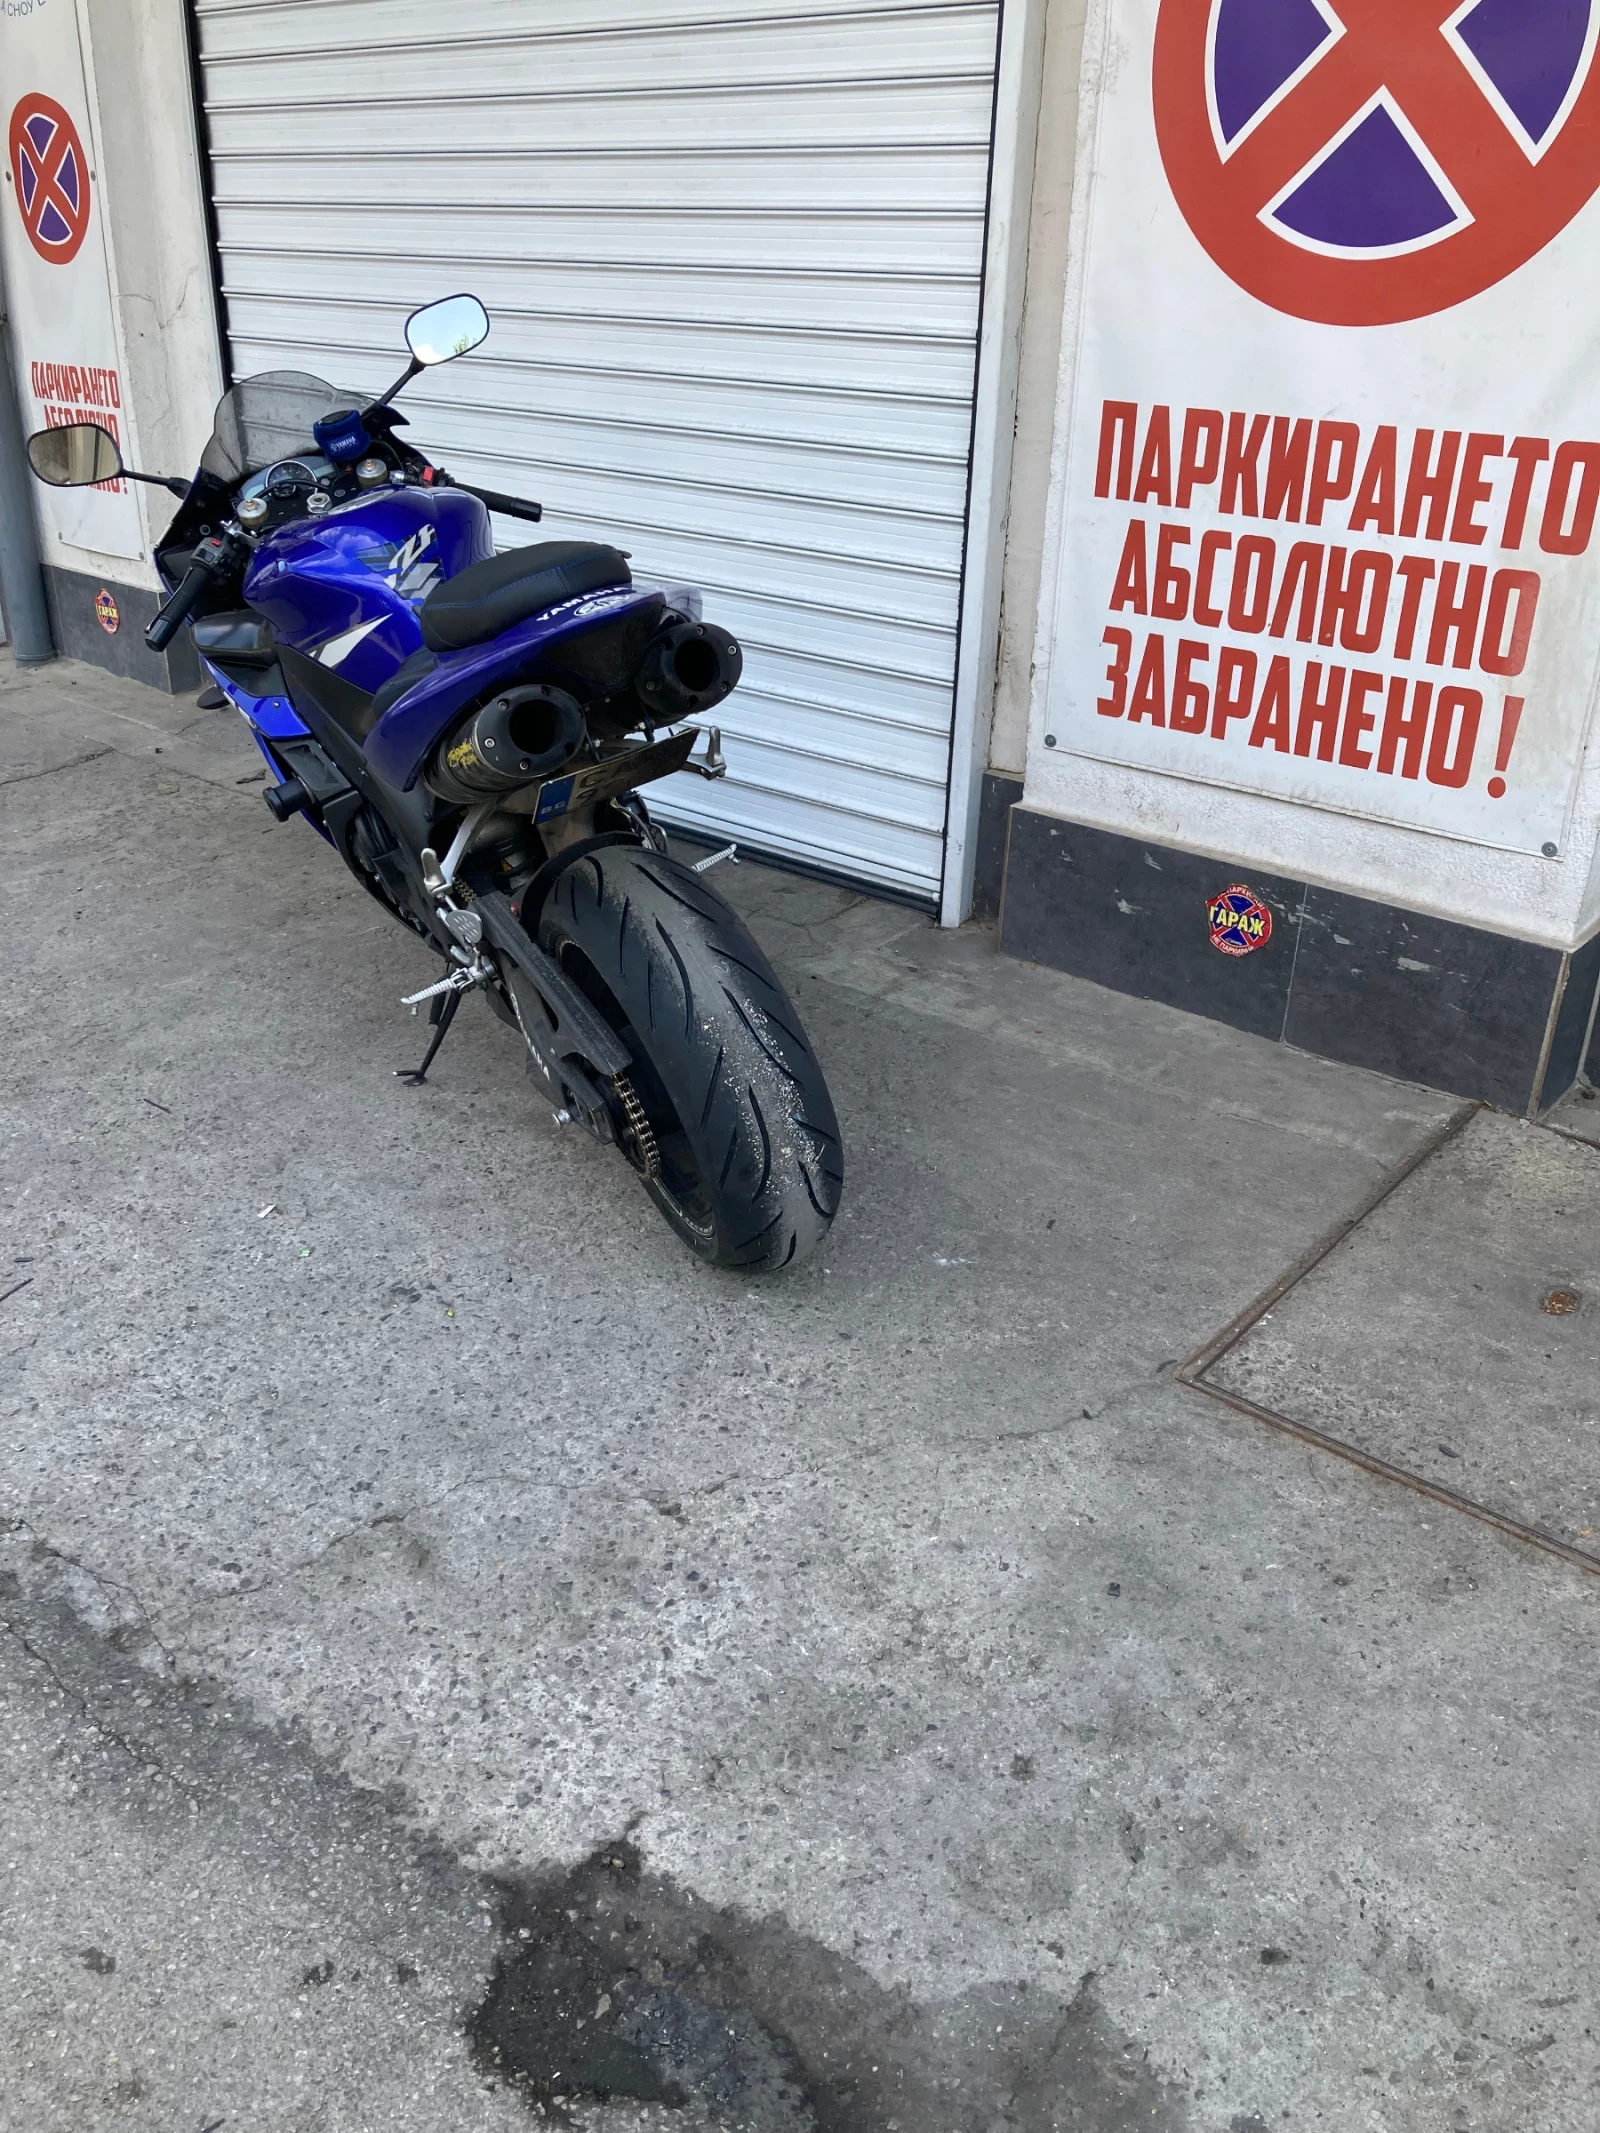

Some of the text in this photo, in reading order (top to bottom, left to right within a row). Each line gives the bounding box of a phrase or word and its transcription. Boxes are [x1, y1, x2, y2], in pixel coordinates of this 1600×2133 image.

[31, 361, 121, 408] ПАРКИРАНЕТО
[1095, 400, 1600, 555] ПАРКИРАНЕТО
[536, 587, 631, 622] YAMAHA
[1109, 520, 1541, 677] АБСОЛЮТНО
[1098, 626, 1524, 799] ЗАБРАНЕНО!
[540, 801, 566, 815] BG
[1209, 905, 1266, 937] ГАРАЖ
